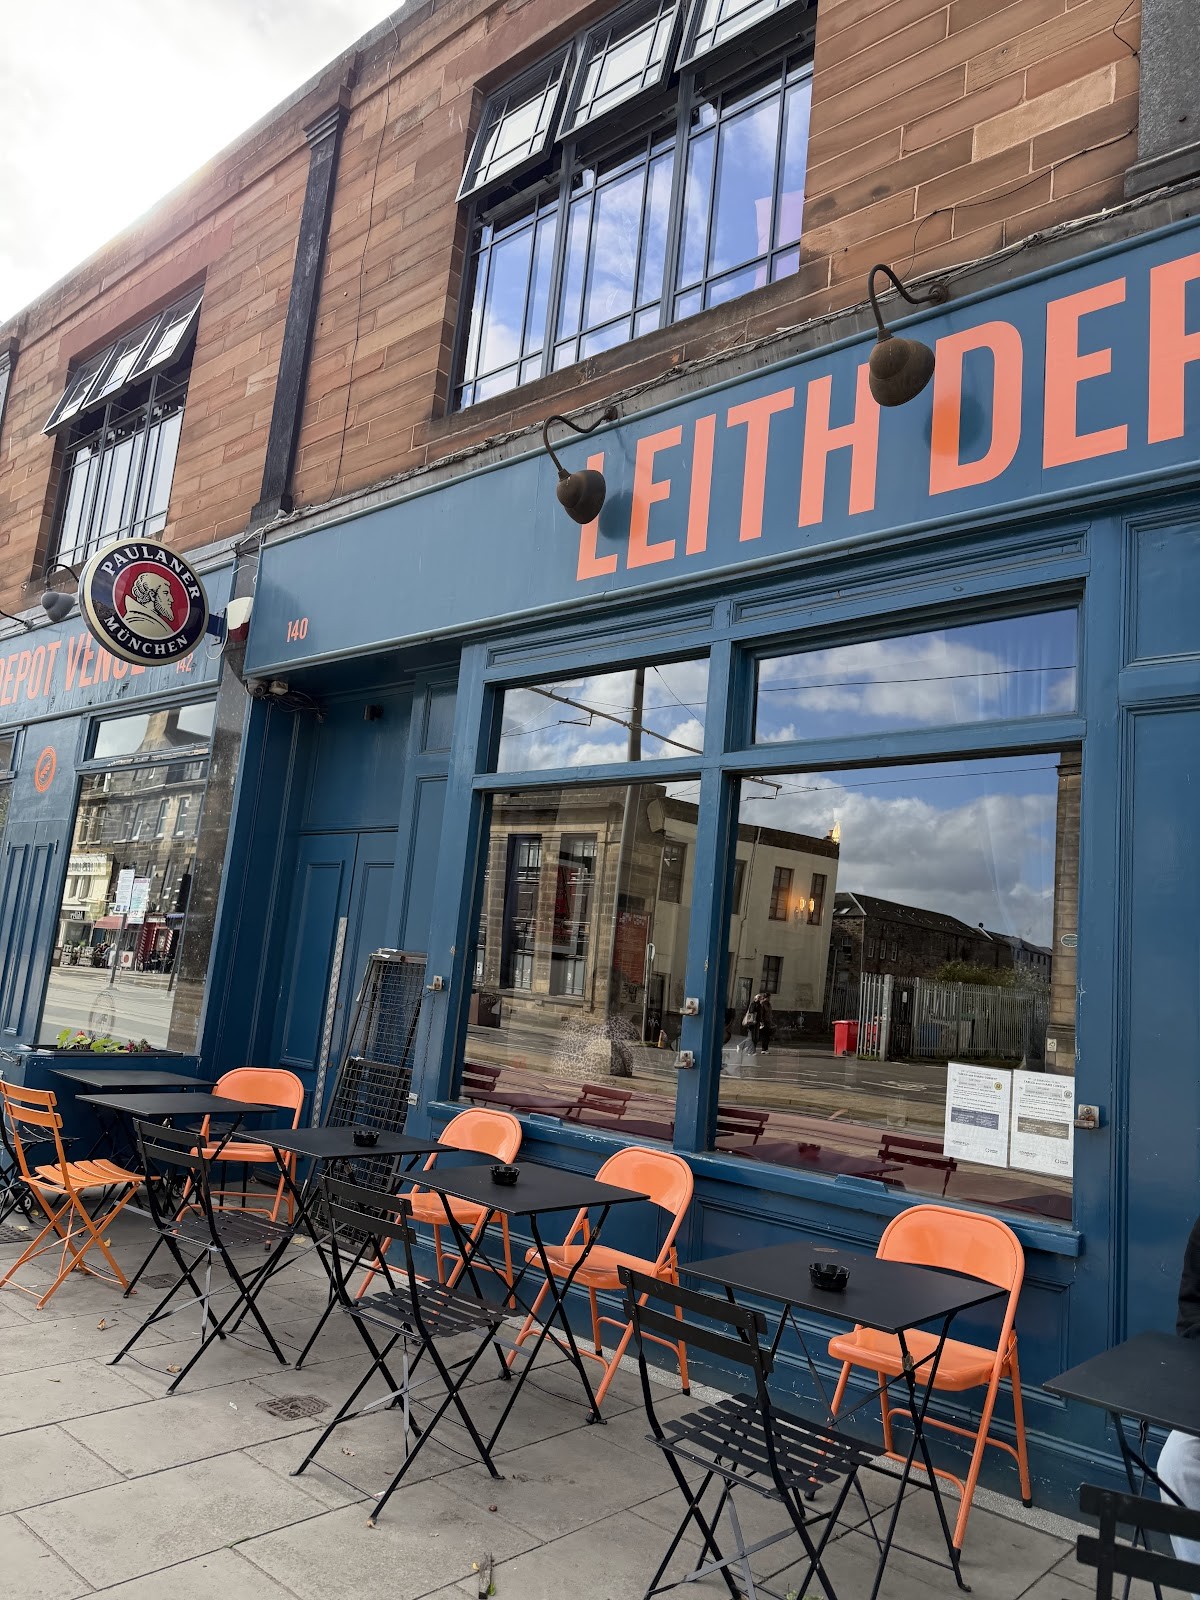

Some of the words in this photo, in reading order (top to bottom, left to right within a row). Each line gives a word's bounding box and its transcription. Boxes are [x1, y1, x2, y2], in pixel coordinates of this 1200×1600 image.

[576, 362, 881, 581] LEITH
[101, 546, 200, 600] PAULANER
[104, 616, 188, 655] MÜNCHEN
[286, 617, 309, 643] 140
